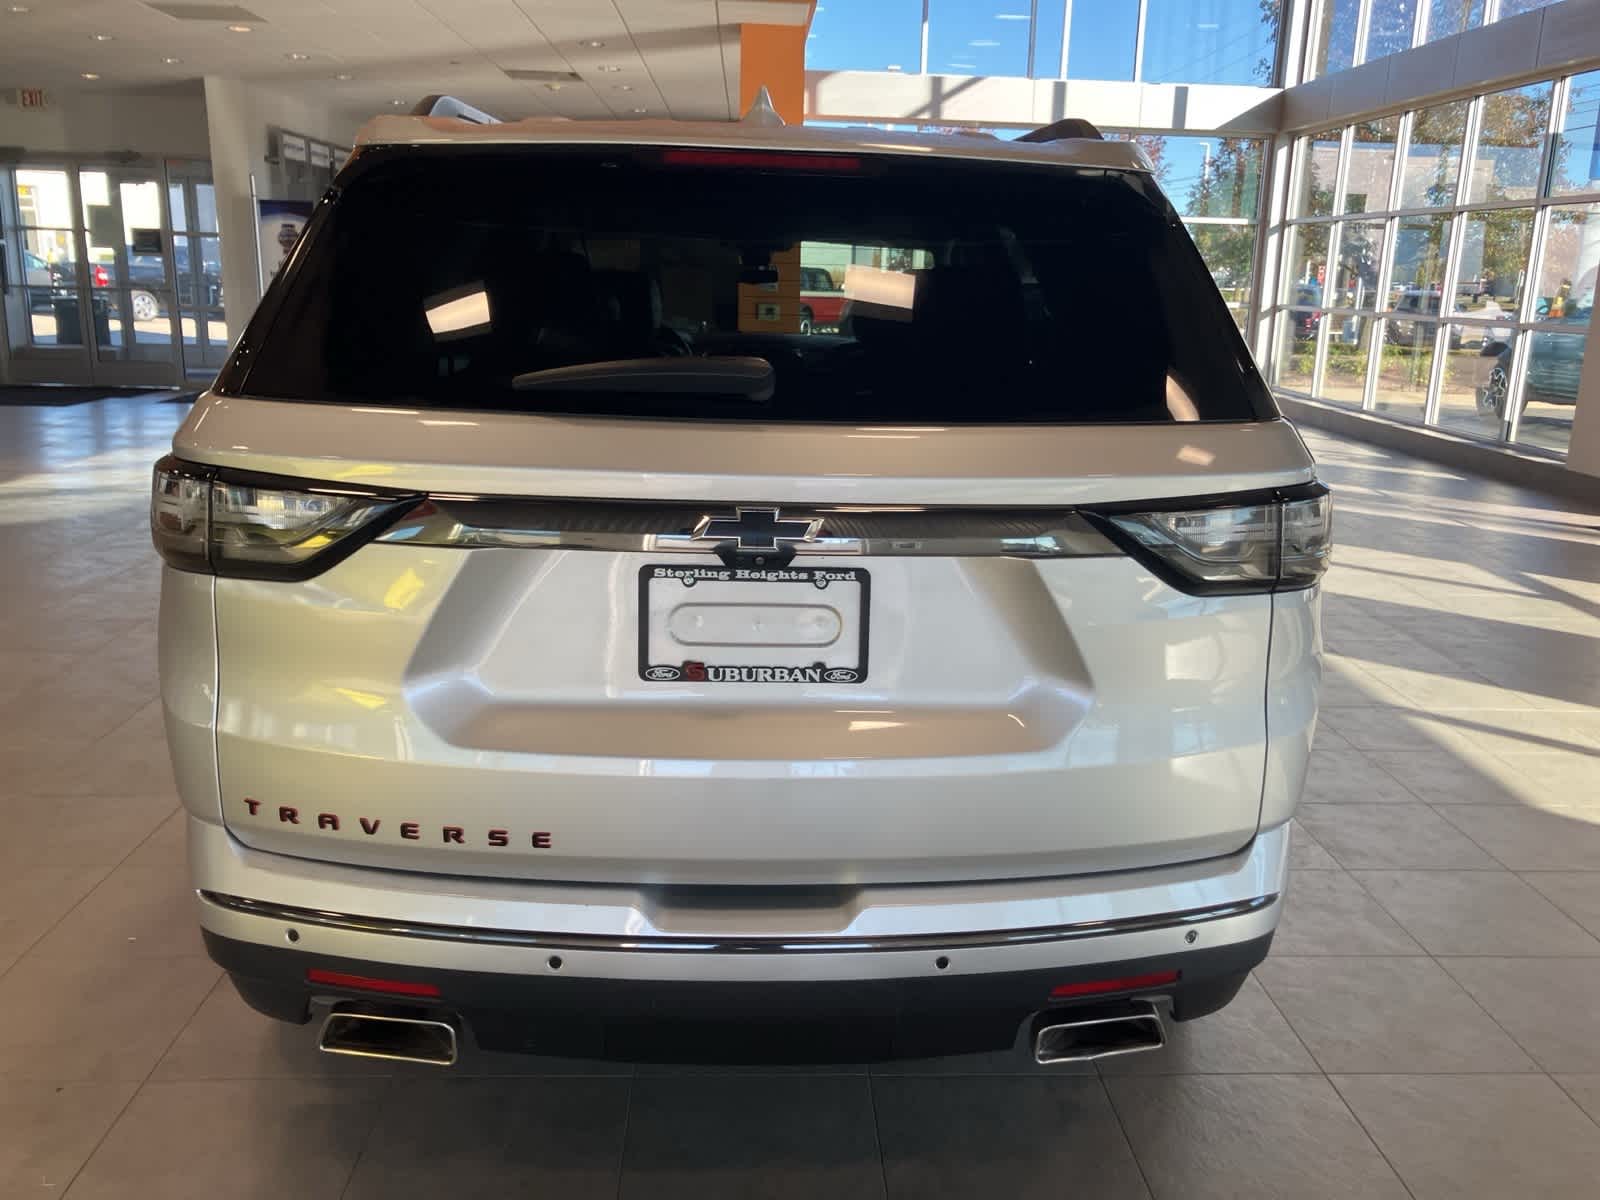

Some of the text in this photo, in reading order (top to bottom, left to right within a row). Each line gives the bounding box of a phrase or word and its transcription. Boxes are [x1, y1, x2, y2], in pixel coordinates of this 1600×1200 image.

[653, 568, 857, 582] Sterling Heights Ford
[685, 662, 821, 683] SUBURBAN
[243, 798, 552, 849] TRAVERSE
